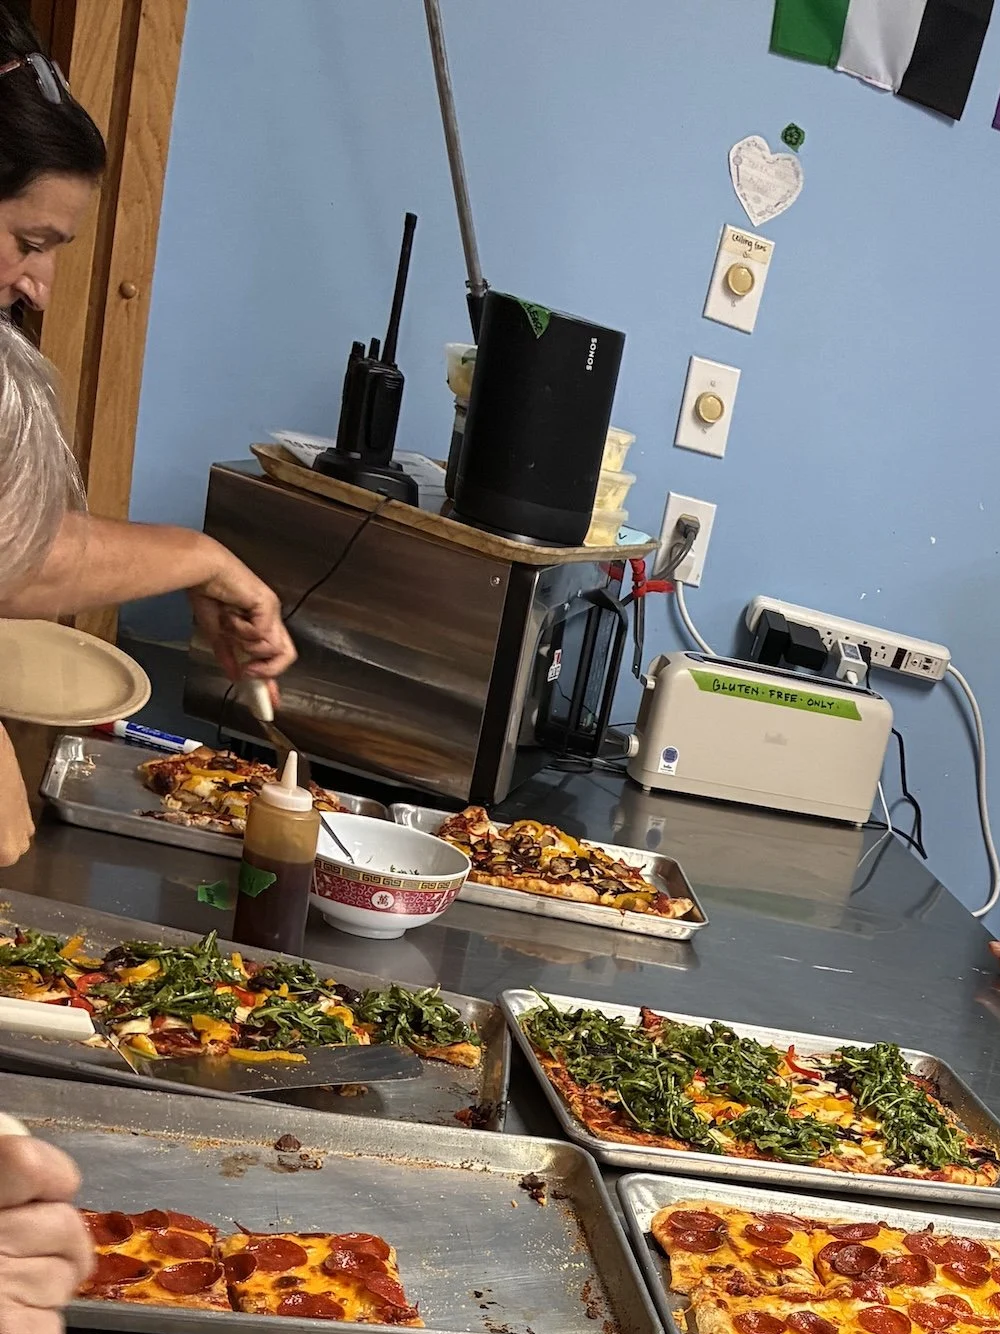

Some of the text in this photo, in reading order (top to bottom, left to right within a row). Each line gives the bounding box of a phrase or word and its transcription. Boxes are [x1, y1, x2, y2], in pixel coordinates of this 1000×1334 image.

[586, 337, 598, 371] SONOS
[712, 679, 835, 710] GLUTEN FREE ONLY
